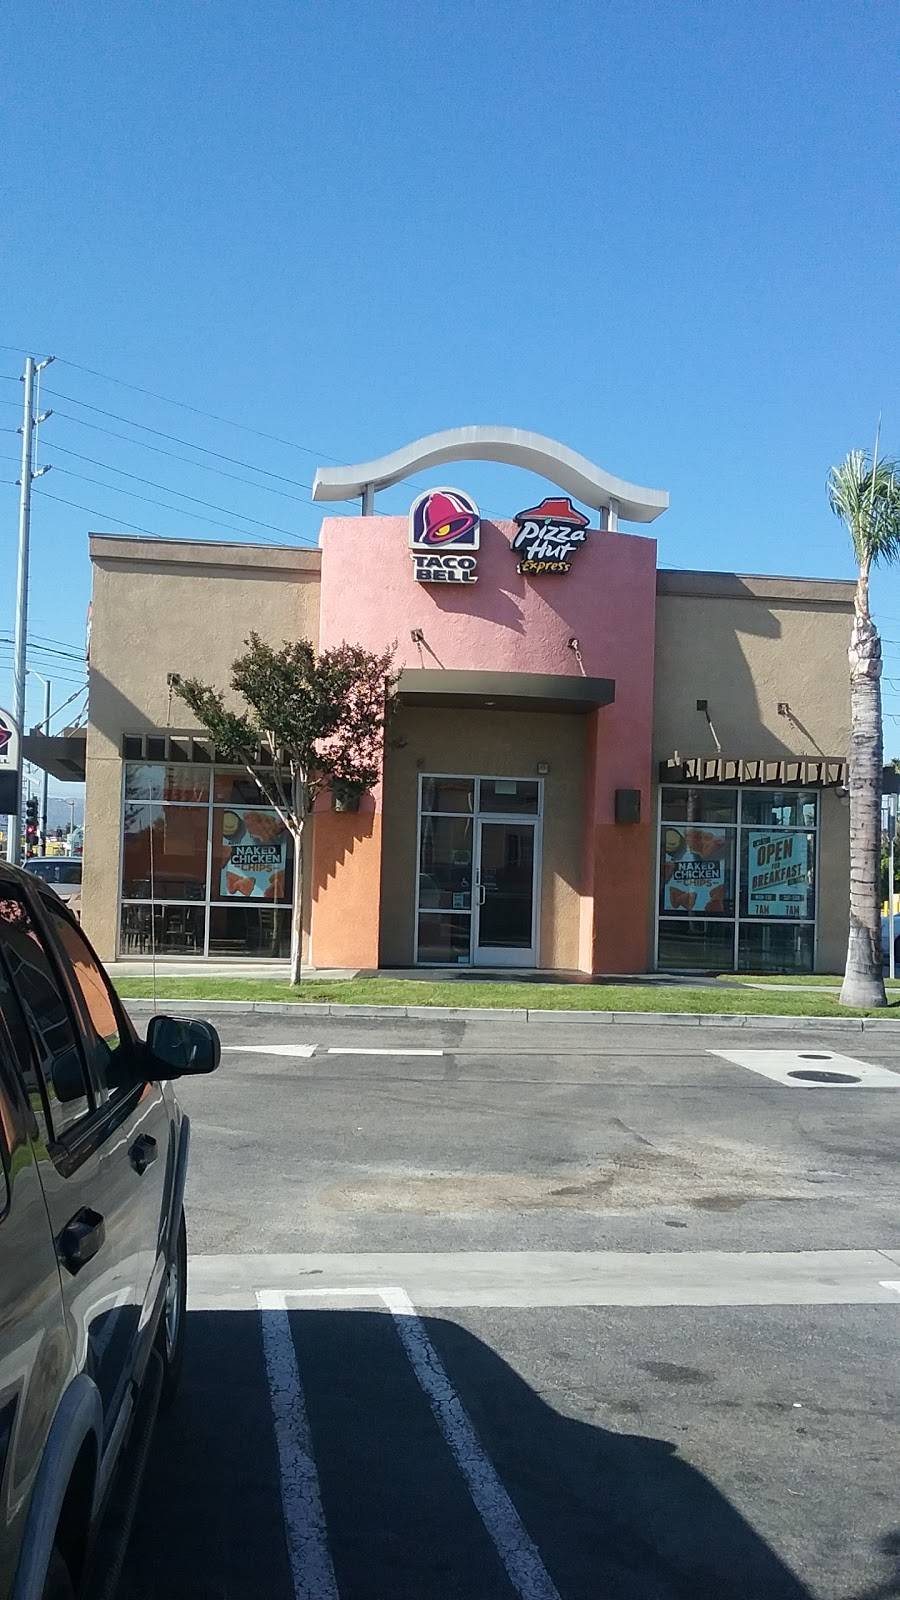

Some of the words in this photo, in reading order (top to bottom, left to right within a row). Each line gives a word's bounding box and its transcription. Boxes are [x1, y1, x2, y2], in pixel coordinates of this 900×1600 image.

[515, 519, 585, 548] Pizza
[527, 539, 576, 560] Hut
[413, 556, 475, 569] TACO
[522, 560, 571, 574] Express
[416, 569, 475, 582] BELL
[236, 846, 276, 855] NAKED
[757, 838, 793, 866] OPEN
[232, 854, 281, 864] CHICKEN
[241, 864, 273, 872] CHIPS
[678, 862, 715, 871] NAKED
[674, 870, 720, 879] CHICKEN
[752, 863, 802, 889] BREAKFAST
[683, 879, 713, 887] CHIPS
